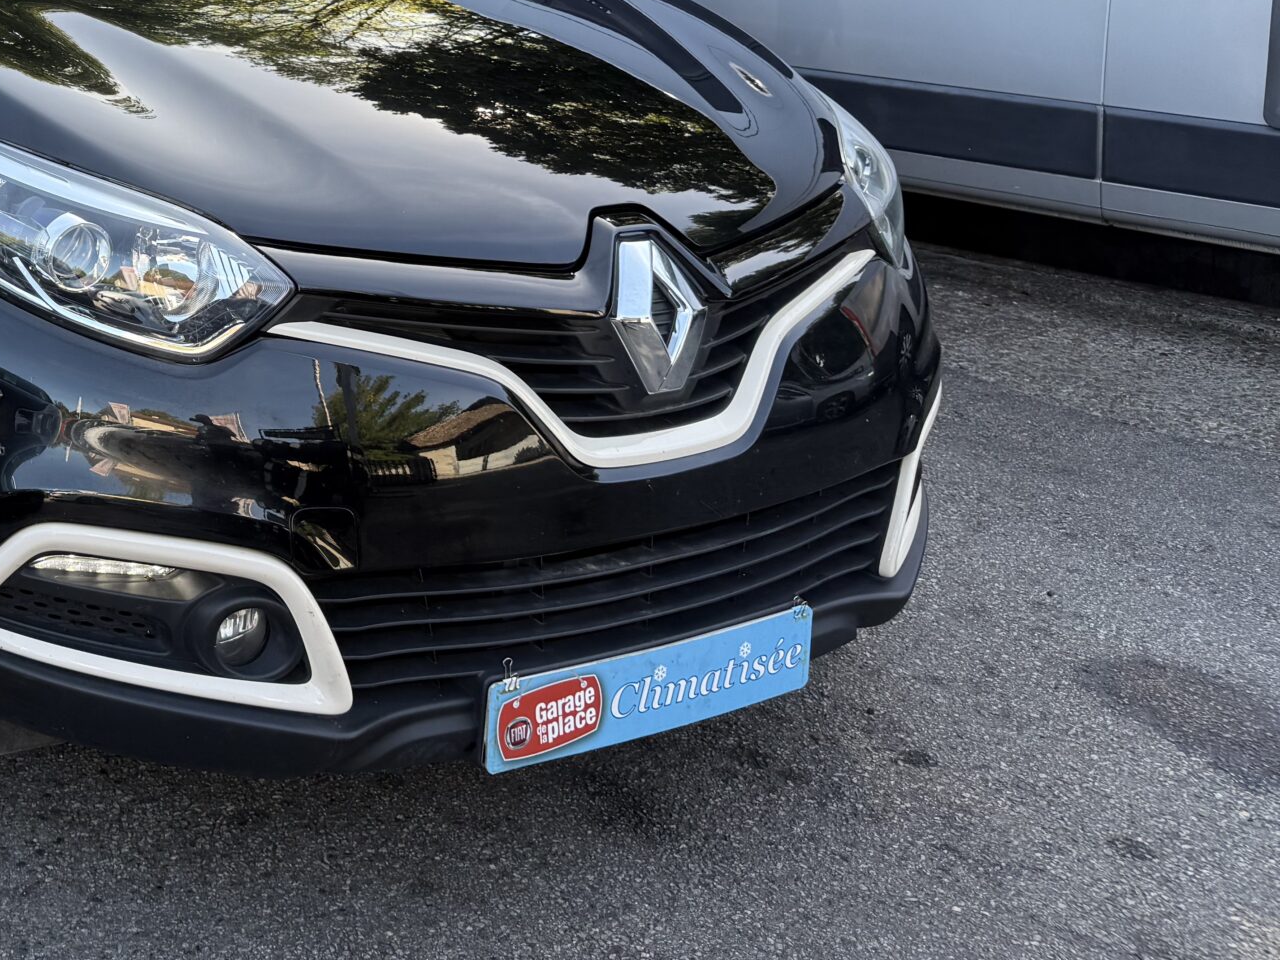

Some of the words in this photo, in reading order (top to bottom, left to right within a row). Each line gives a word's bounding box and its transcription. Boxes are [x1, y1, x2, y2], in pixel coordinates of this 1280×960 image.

[610, 637, 803, 720] Climatisée
[535, 687, 596, 724] Garage
[510, 724, 527, 743] FIAT
[536, 724, 547, 736] de
[540, 734, 548, 745] la
[547, 707, 597, 744] place
